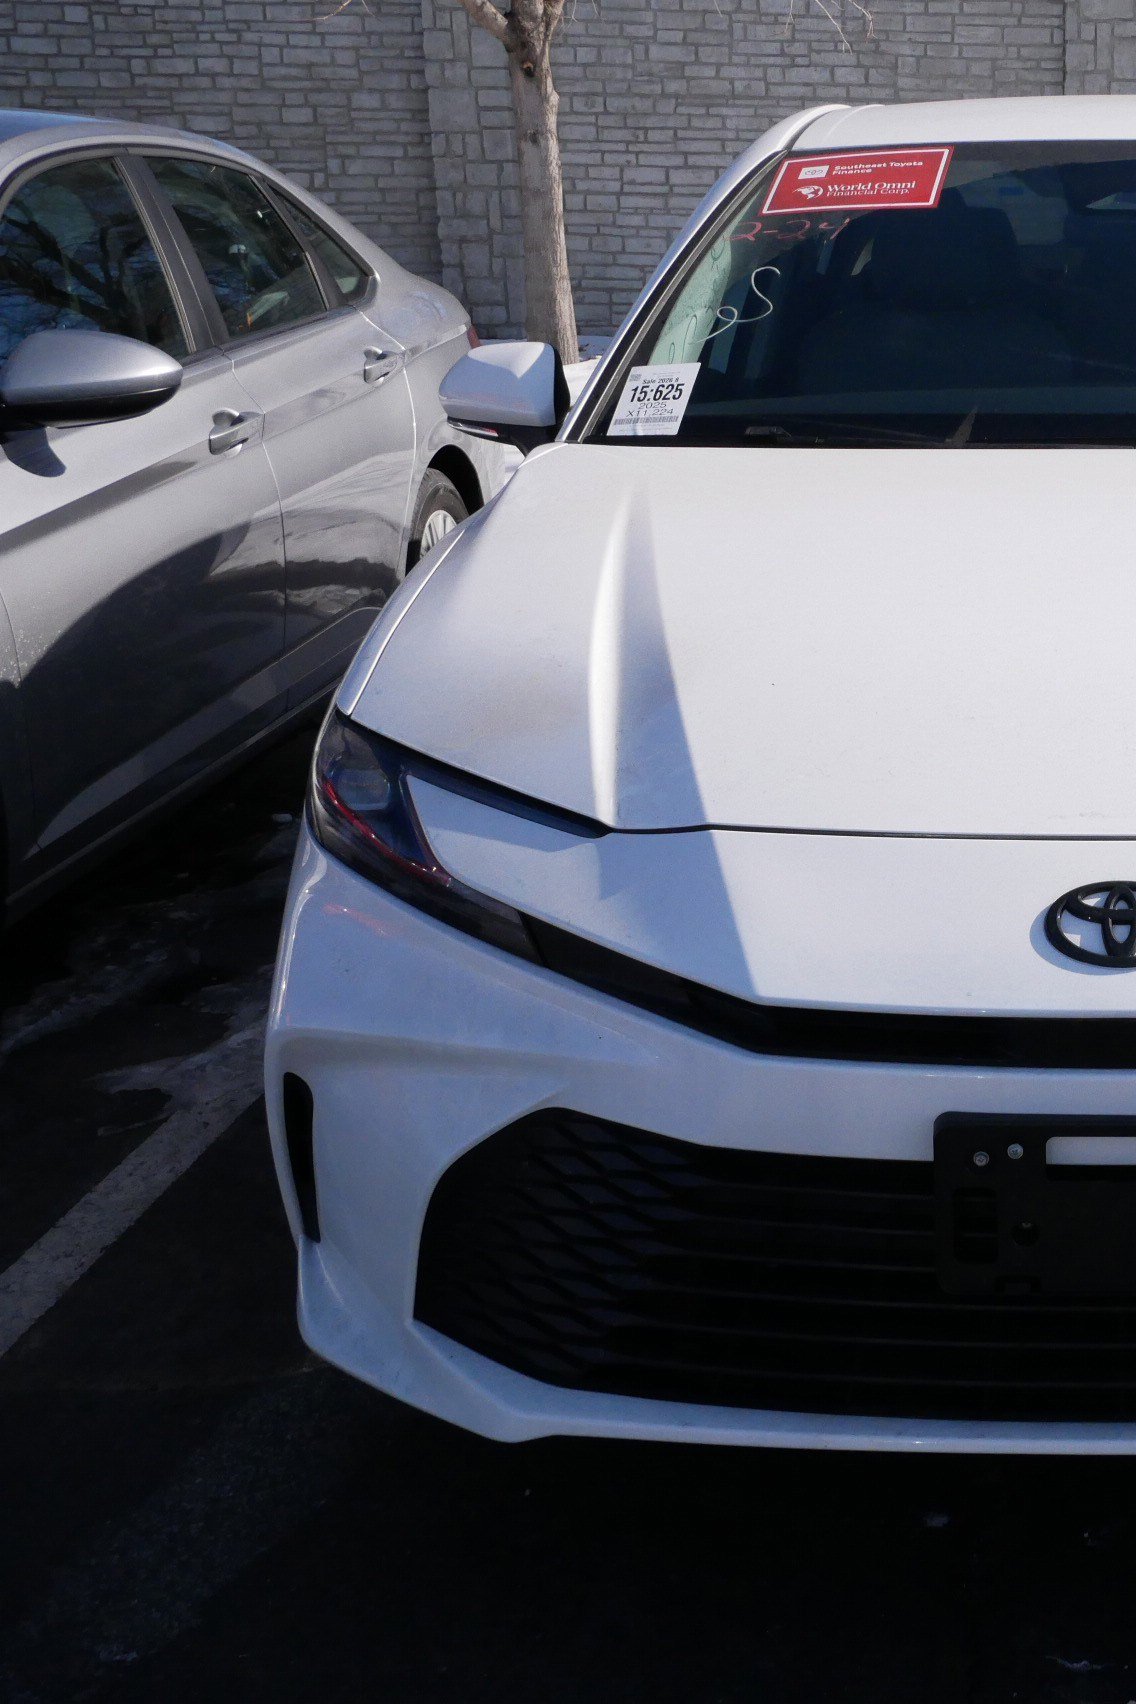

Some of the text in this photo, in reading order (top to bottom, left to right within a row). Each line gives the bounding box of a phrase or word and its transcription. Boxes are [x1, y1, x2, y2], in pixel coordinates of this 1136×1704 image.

[827, 181, 916, 191] World Omni
[826, 187, 910, 197] Financial Corp.
[630, 383, 685, 402] 15:625
